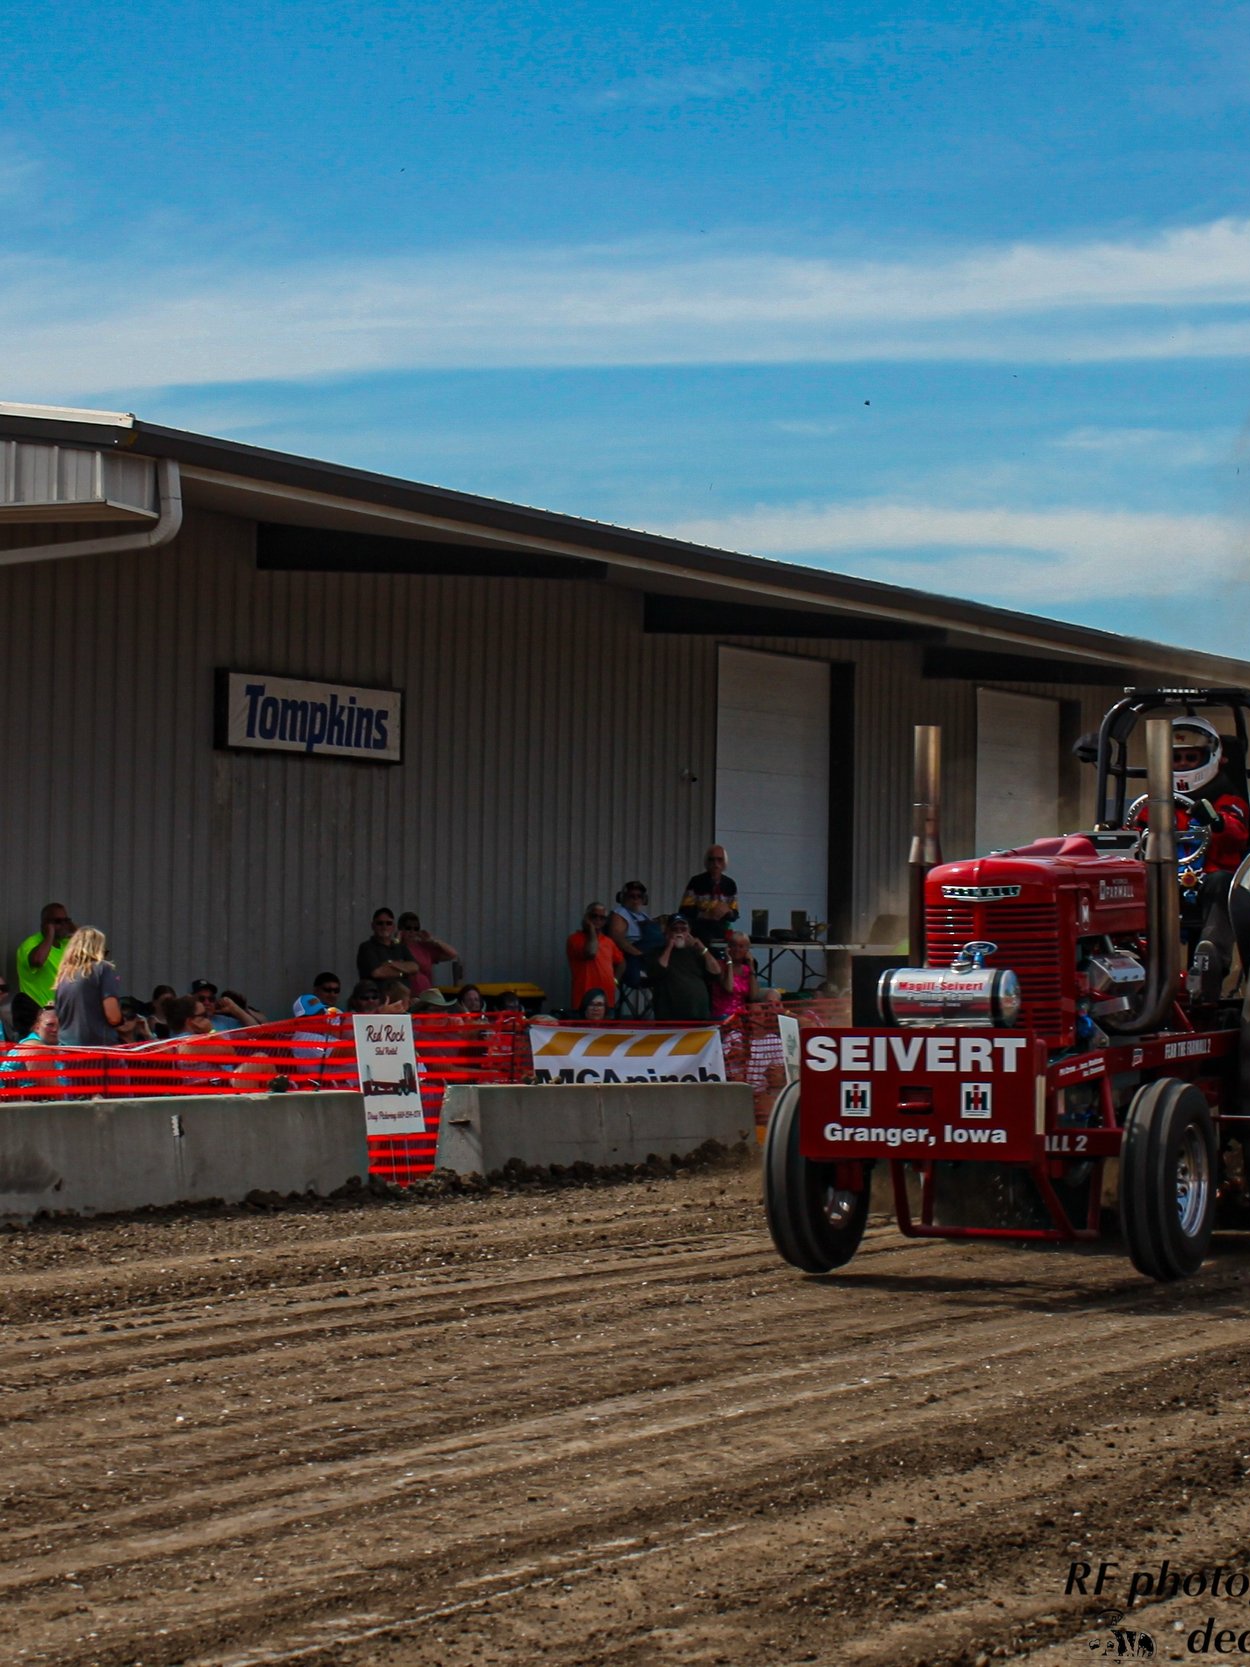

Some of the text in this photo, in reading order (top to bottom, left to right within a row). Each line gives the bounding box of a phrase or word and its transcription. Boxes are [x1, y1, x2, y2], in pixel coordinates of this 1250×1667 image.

[245, 684, 388, 752] Tompkins
[898, 982, 983, 993] Magill-Seivert
[366, 1024, 405, 1042] Red Rock
[805, 1035, 1027, 1073] SEIVERT
[823, 1122, 1008, 1148] Granger, Iowa
[1074, 1135, 1089, 1152] 2
